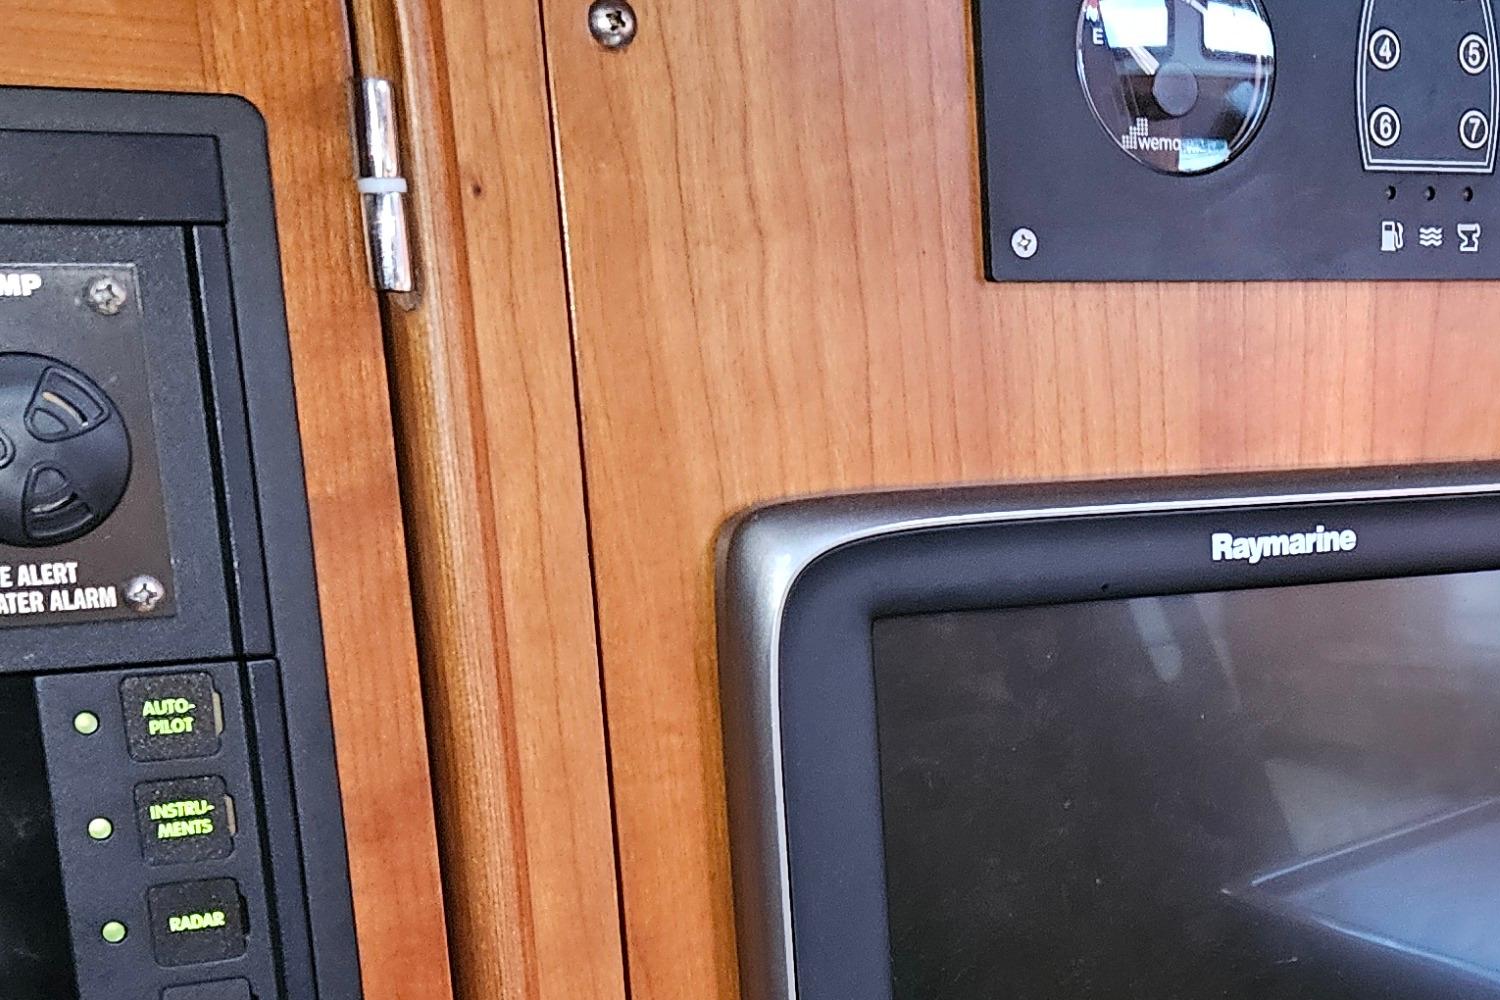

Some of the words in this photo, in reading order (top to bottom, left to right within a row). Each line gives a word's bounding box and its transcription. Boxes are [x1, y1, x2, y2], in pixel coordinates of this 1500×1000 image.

[1093, 28, 1104, 45] E
[1211, 525, 1357, 564] Raymarine
[17, 562, 78, 587] ALERT
[50, 586, 117, 611] ALARM
[143, 698, 196, 718] AUTO-
[149, 716, 194, 735] PILOT
[149, 800, 215, 820] INSTRU-
[157, 819, 214, 839] MENTS
[168, 911, 226, 932] RADAR
